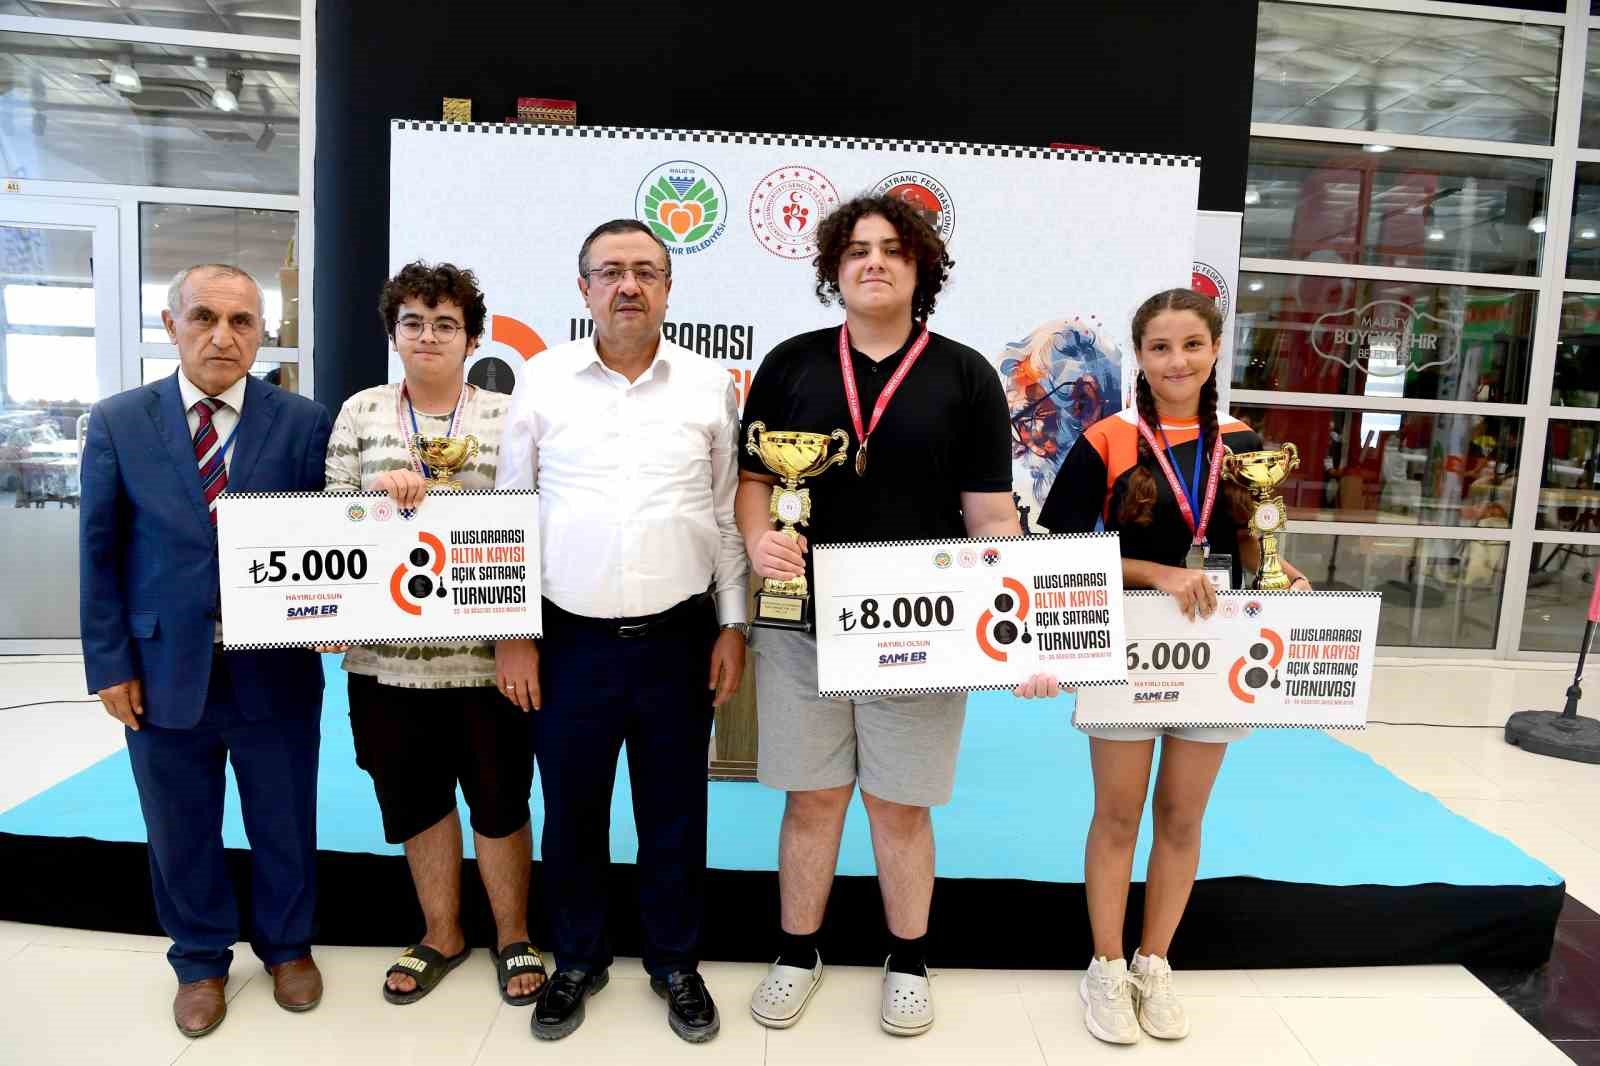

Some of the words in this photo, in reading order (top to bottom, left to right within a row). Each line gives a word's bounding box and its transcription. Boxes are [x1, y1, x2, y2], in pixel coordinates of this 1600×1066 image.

[879, 175, 918, 193] SATRANÇ
[686, 222, 727, 255] BELEDİYESİ
[570, 318, 754, 361] URARASI
[451, 529, 525, 545] ULUSLARARASI
[451, 547, 483, 564] ALTIN
[487, 545, 525, 562] KAYISI
[452, 566, 476, 584] AÇIK
[479, 565, 526, 582] SATRANÇ
[1033, 572, 1107, 589] ULUSLARARASI
[452, 585, 526, 605] TURNUVASI
[1035, 592, 1066, 609] ALTIN
[1070, 590, 1108, 608] KAYISI
[321, 604, 338, 615] ER
[1036, 611, 1060, 629] AÇIK
[1063, 609, 1109, 626] SATRANÇ
[1037, 630, 1111, 651] TURNUVASI
[1290, 628, 1362, 642] ULUSLARARASI
[910, 651, 927, 662] ER
[1288, 644, 1319, 659] ALTIN
[1322, 645, 1360, 660] KAYISI
[1286, 661, 1310, 677] AÇIK
[1312, 662, 1359, 678] SATRANÇ
[1163, 691, 1179, 700] ER
[1285, 680, 1356, 697] TURNUVASI
[506, 955, 542, 970] PUMA
